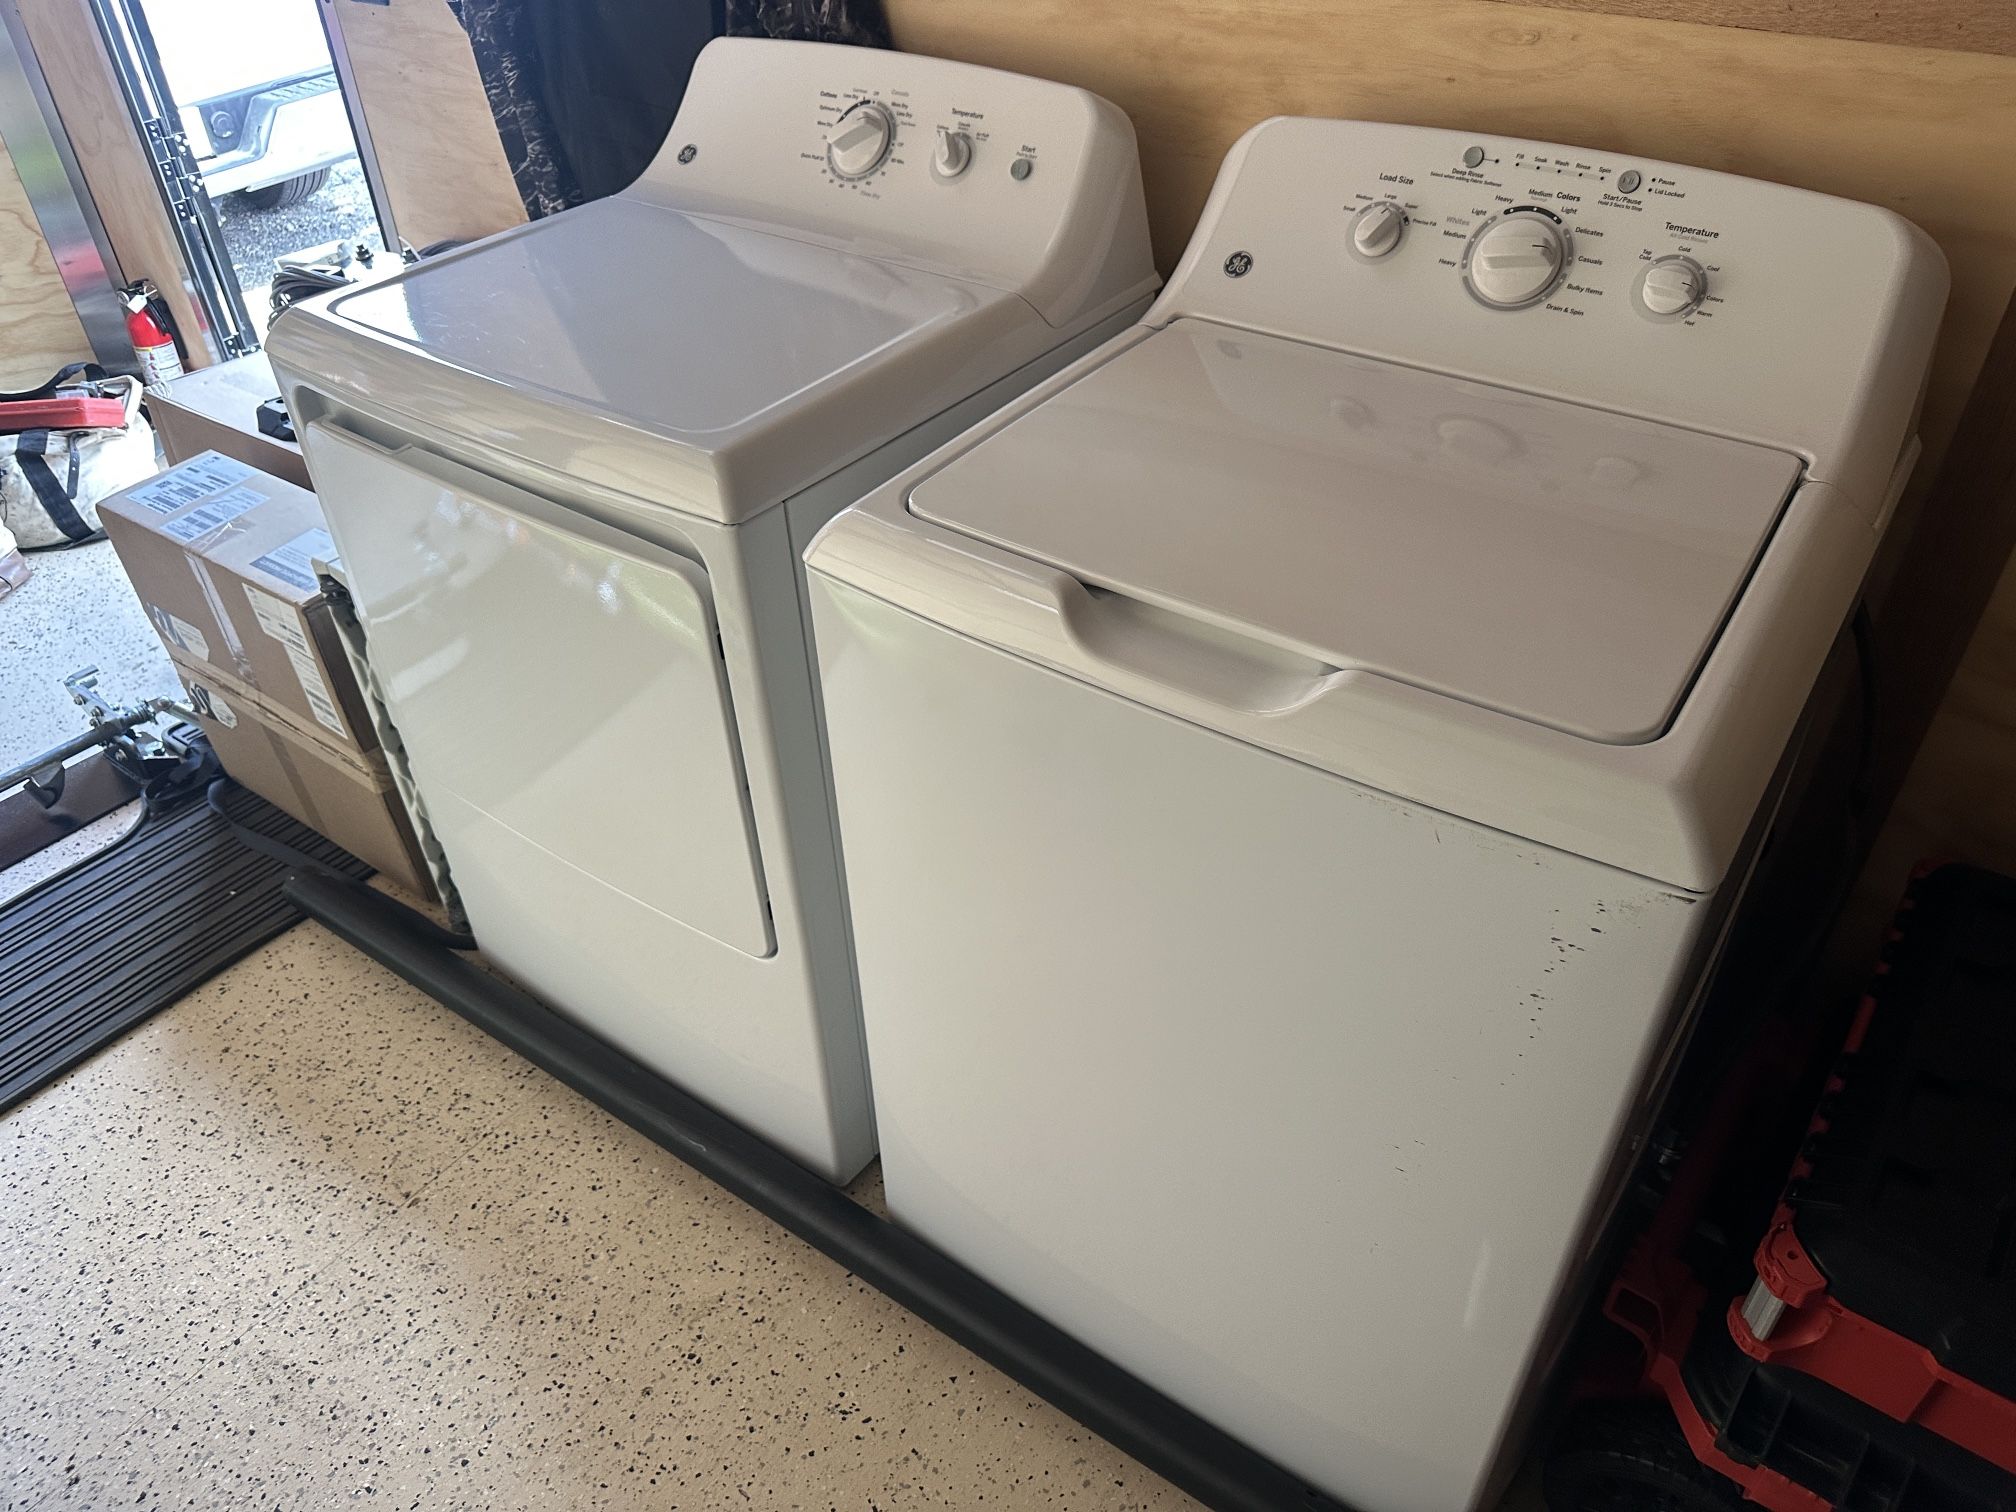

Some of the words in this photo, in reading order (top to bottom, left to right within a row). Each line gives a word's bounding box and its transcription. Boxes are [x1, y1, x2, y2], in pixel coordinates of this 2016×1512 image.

[952, 108, 984, 119] Temperature
[1021, 145, 1036, 153] Start
[1452, 168, 1466, 176] Deep
[1379, 173, 1397, 182] Load
[1399, 176, 1413, 184] Size
[1658, 178, 1675, 186] Pause
[1529, 189, 1552, 198] Medium
[1556, 192, 1581, 202] Colors
[1664, 190, 1685, 198] Locked
[1495, 195, 1513, 203] Heavy
[1603, 194, 1642, 205] Start/Pause
[1472, 208, 1487, 216] Light
[1446, 216, 1470, 226] Whites
[1443, 230, 1466, 239] Medium
[1575, 227, 1603, 237] Delicates
[1665, 222, 1719, 239] Temperature
[1439, 258, 1456, 267] Heavy
[1578, 256, 1603, 265] Casuals
[1567, 284, 1584, 292] Bulky
[1546, 304, 1562, 312] Drain
[1570, 308, 1584, 316] Spin
